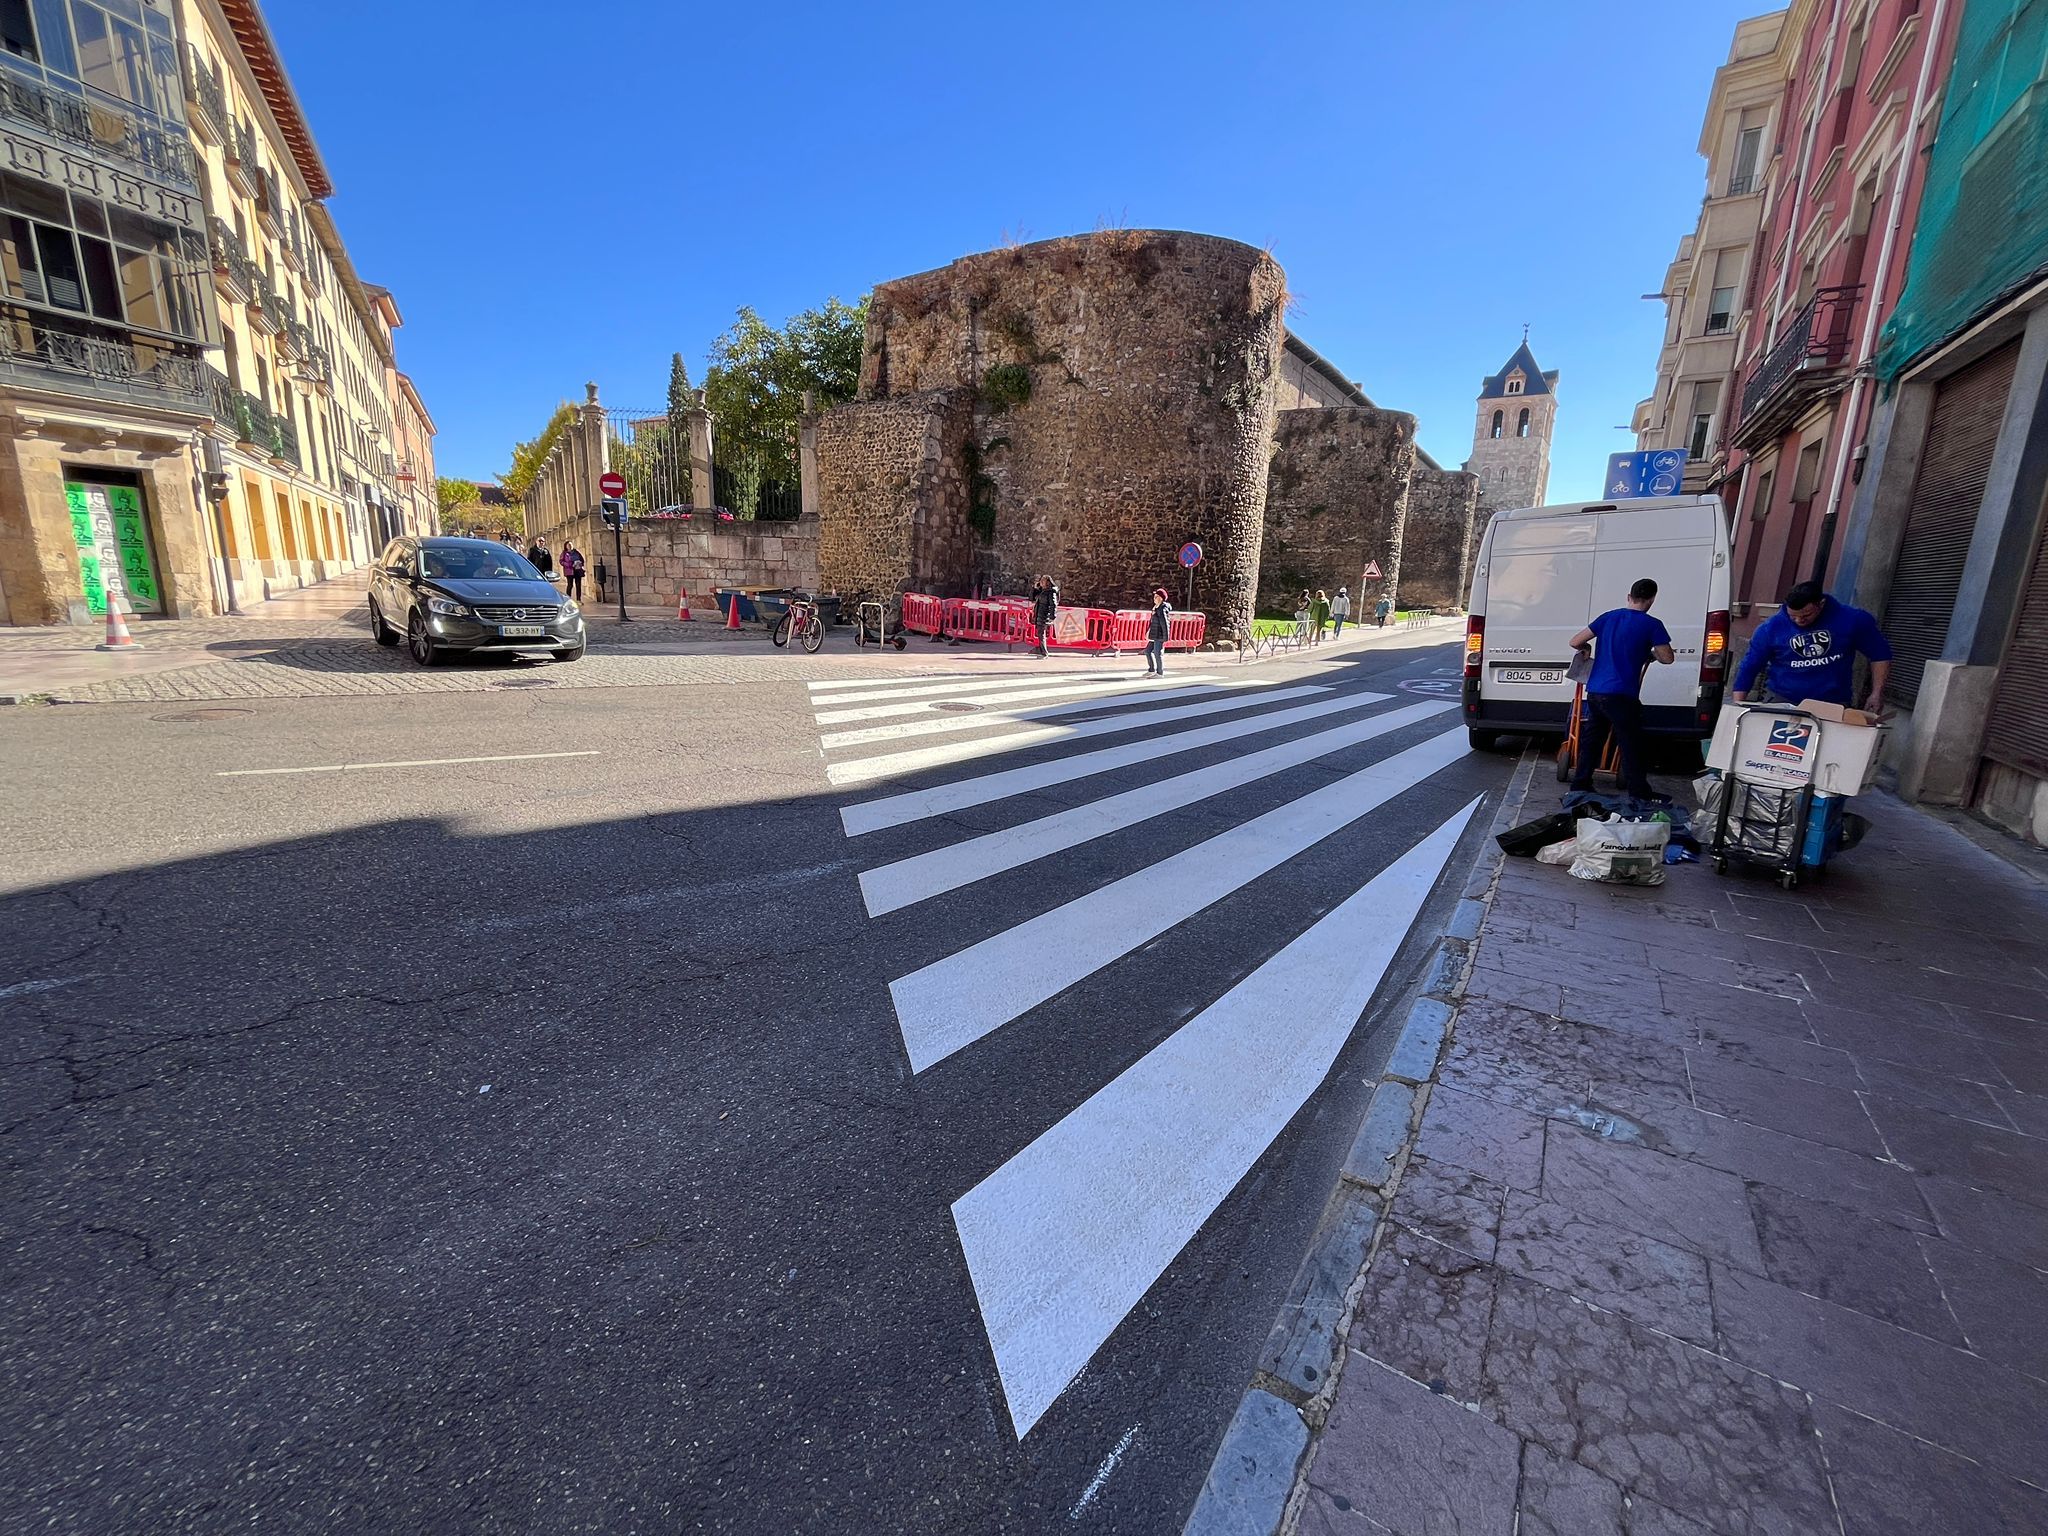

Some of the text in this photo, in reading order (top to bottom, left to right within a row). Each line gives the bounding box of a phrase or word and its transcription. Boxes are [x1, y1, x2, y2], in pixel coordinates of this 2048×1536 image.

[1792, 631, 1829, 649] NETS
[1506, 671, 1560, 681] 8045 GBJ
